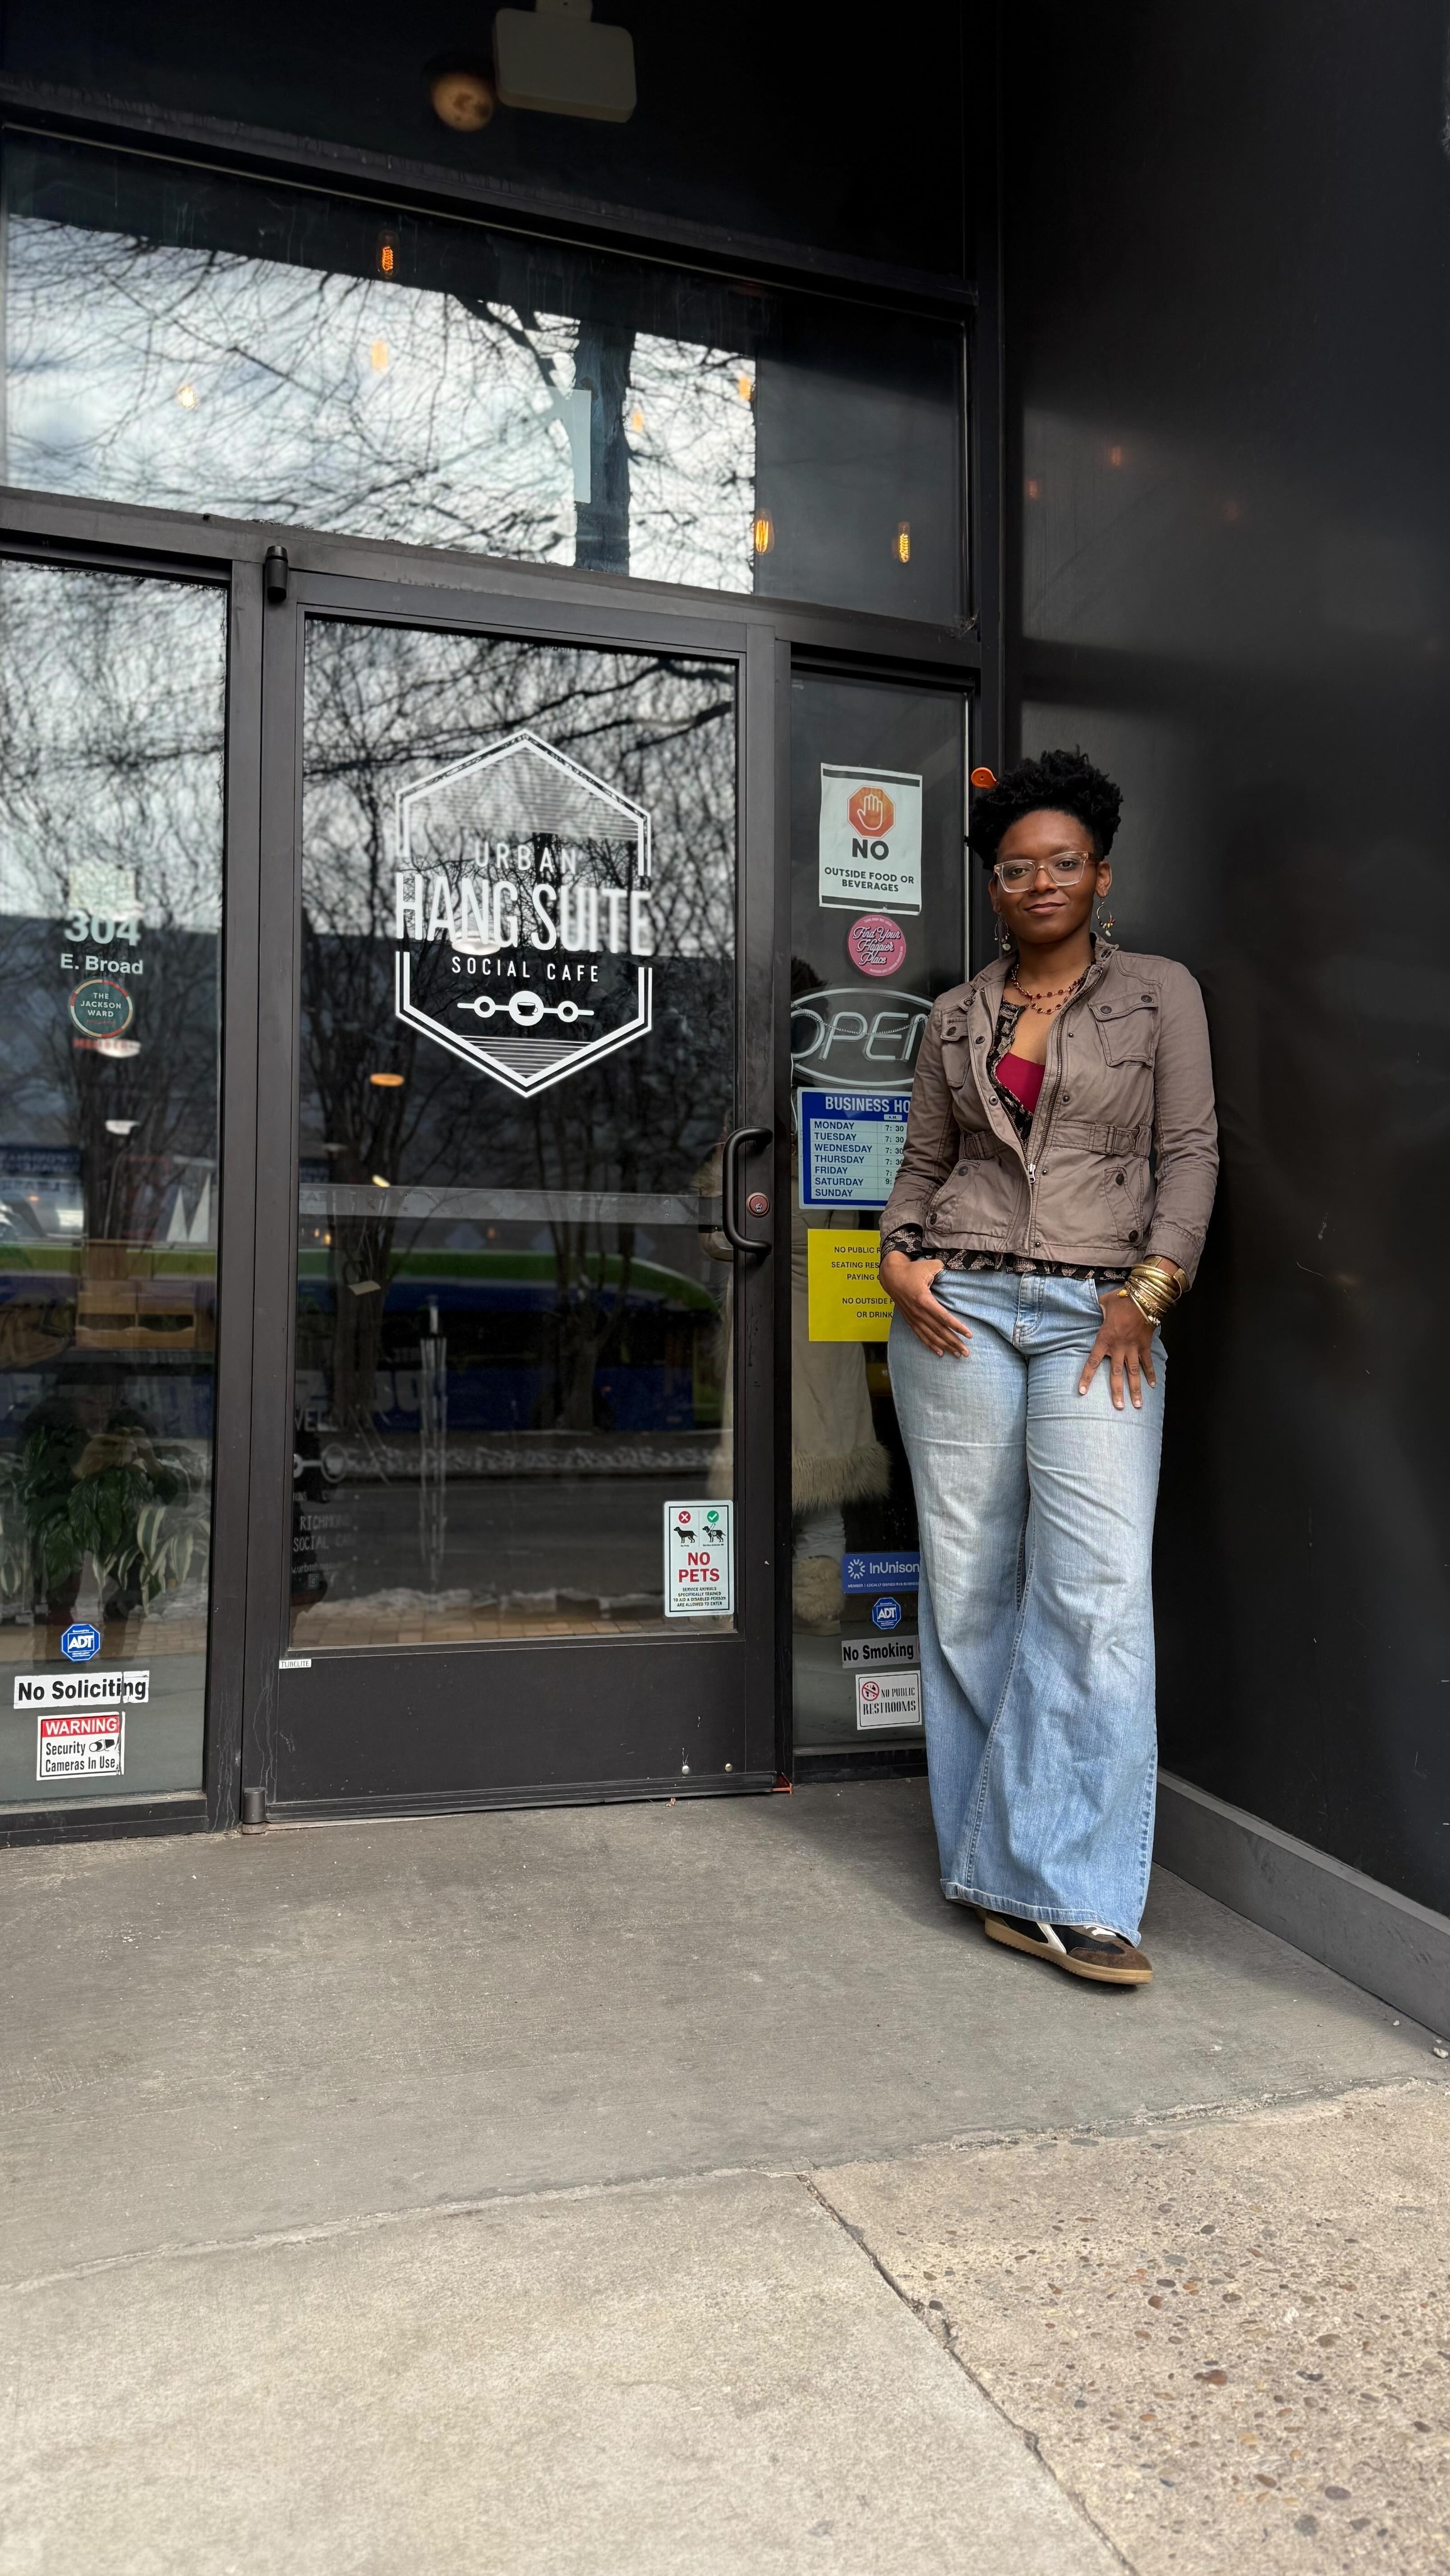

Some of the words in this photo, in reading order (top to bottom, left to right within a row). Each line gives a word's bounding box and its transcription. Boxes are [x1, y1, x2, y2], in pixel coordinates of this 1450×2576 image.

[851, 838, 889, 861] NO
[474, 841, 577, 875] URBAN
[824, 866, 866, 880] OUTSIDE
[869, 872, 897, 883] FOOD
[900, 875, 914, 884] OR
[841, 879, 899, 892] BEVERAGES
[396, 872, 517, 948] HANG
[531, 884, 652, 956] SUITE
[64, 909, 141, 946] 304
[853, 926, 877, 939] Find
[877, 926, 901, 942] Your
[856, 939, 894, 955] Happier
[61, 953, 79, 970] E.
[86, 955, 143, 974] Broad
[858, 951, 887, 965] Place
[451, 956, 530, 978] SOCIAL
[547, 963, 599, 982] CAFE
[80, 1001, 121, 1009] JACKSON
[825, 1096, 890, 1113] BUSINESS
[814, 1121, 855, 1130] MONDAY
[814, 1132, 856, 1141] TUESDAY
[814, 1144, 872, 1153] WEDNESDAY
[814, 1155, 865, 1164] THURSDAY
[815, 1166, 848, 1175] FRIDAY
[815, 1177, 863, 1187] SATURDAY
[815, 1189, 853, 1197] SUNDAY
[688, 1552, 711, 1565] NO
[870, 1561, 920, 1574] InUnison
[678, 1568, 720, 1583] PETS
[878, 1607, 896, 1619] ADT
[69, 1635, 94, 1650] ADT
[843, 1646, 859, 1662] No
[863, 1643, 914, 1660] Smoking
[18, 1682, 45, 1701] No
[52, 1678, 146, 1700] Soliciting
[881, 1689, 890, 1698] NO
[892, 1687, 915, 1697] PUBLIC
[863, 1700, 916, 1715] RESTROOMS
[45, 1718, 118, 1735] WARNING
[46, 1741, 86, 1755] Security
[45, 1759, 85, 1772] Cameras
[88, 1757, 96, 1769] In
[99, 1755, 115, 1768] Use
